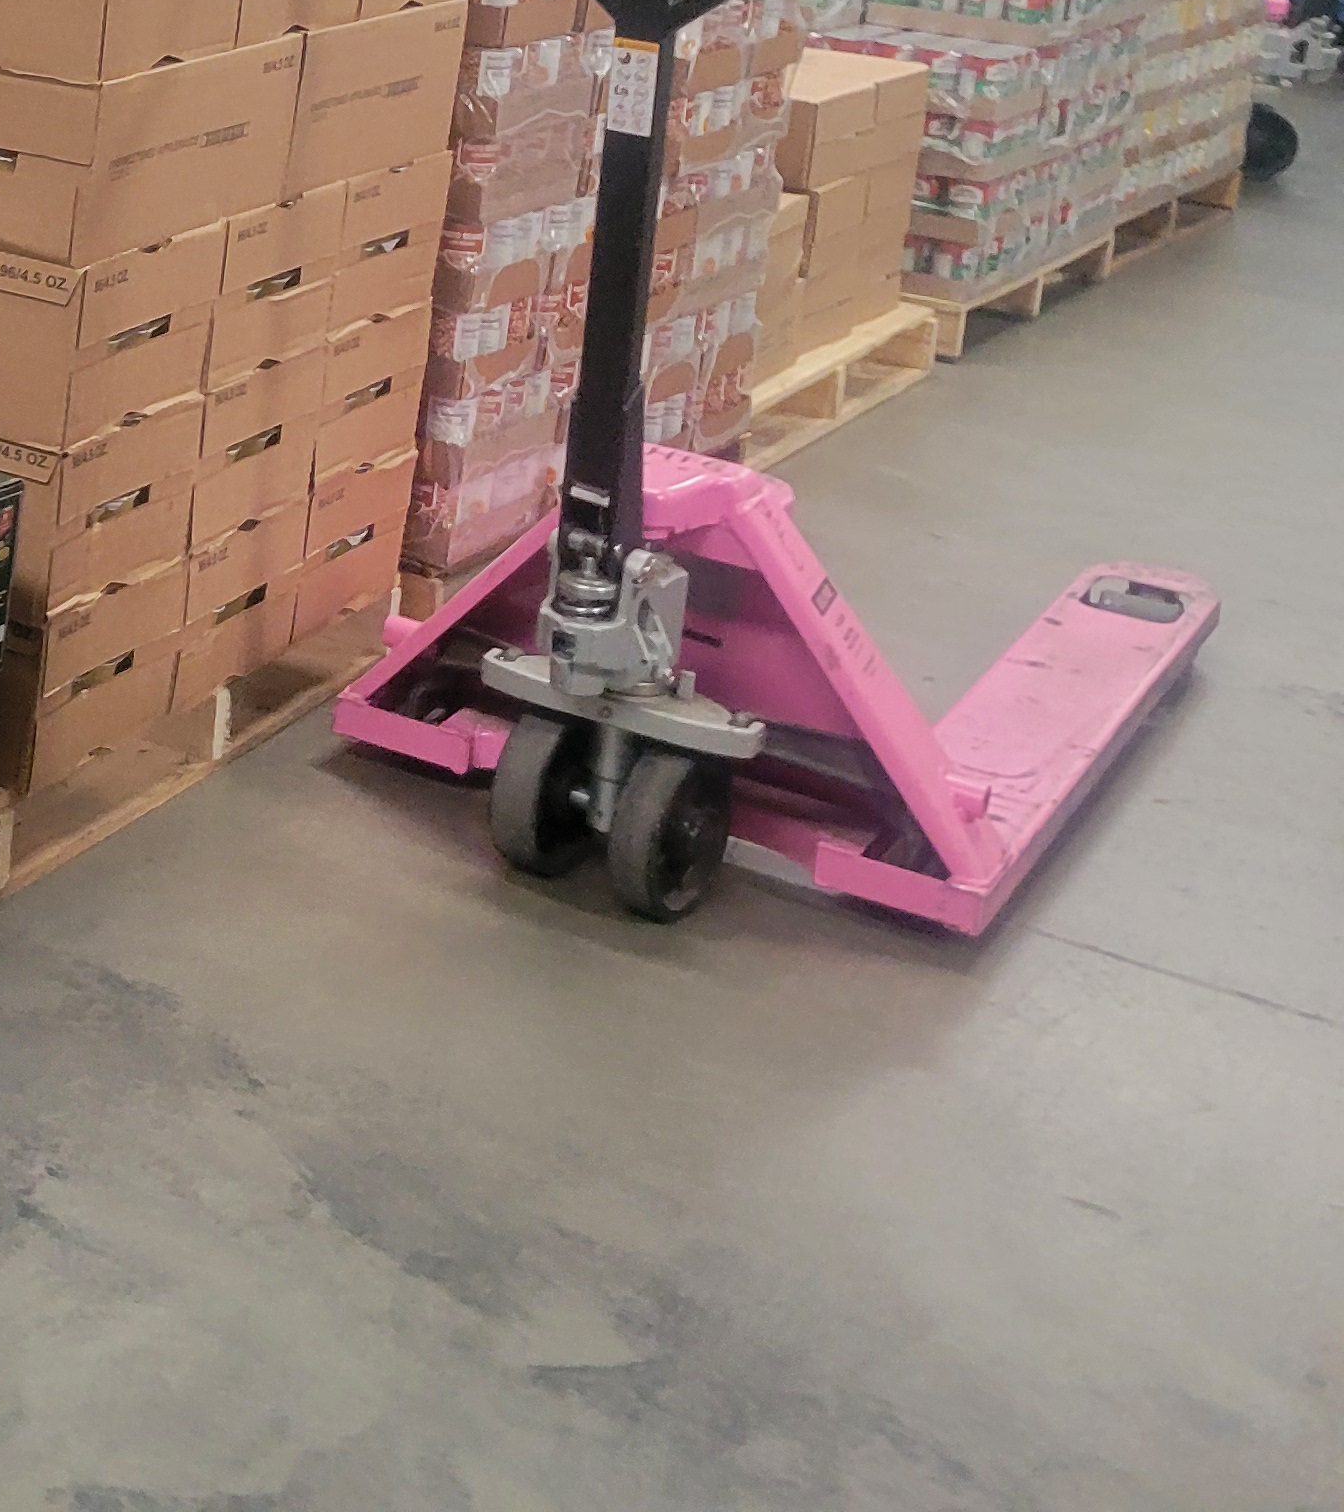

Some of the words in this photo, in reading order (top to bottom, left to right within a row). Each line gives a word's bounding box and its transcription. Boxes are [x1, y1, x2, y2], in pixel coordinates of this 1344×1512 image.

[0, 265, 43, 286] 96/4.5
[45, 275, 68, 291] OZ
[25, 451, 51, 469] OZ
